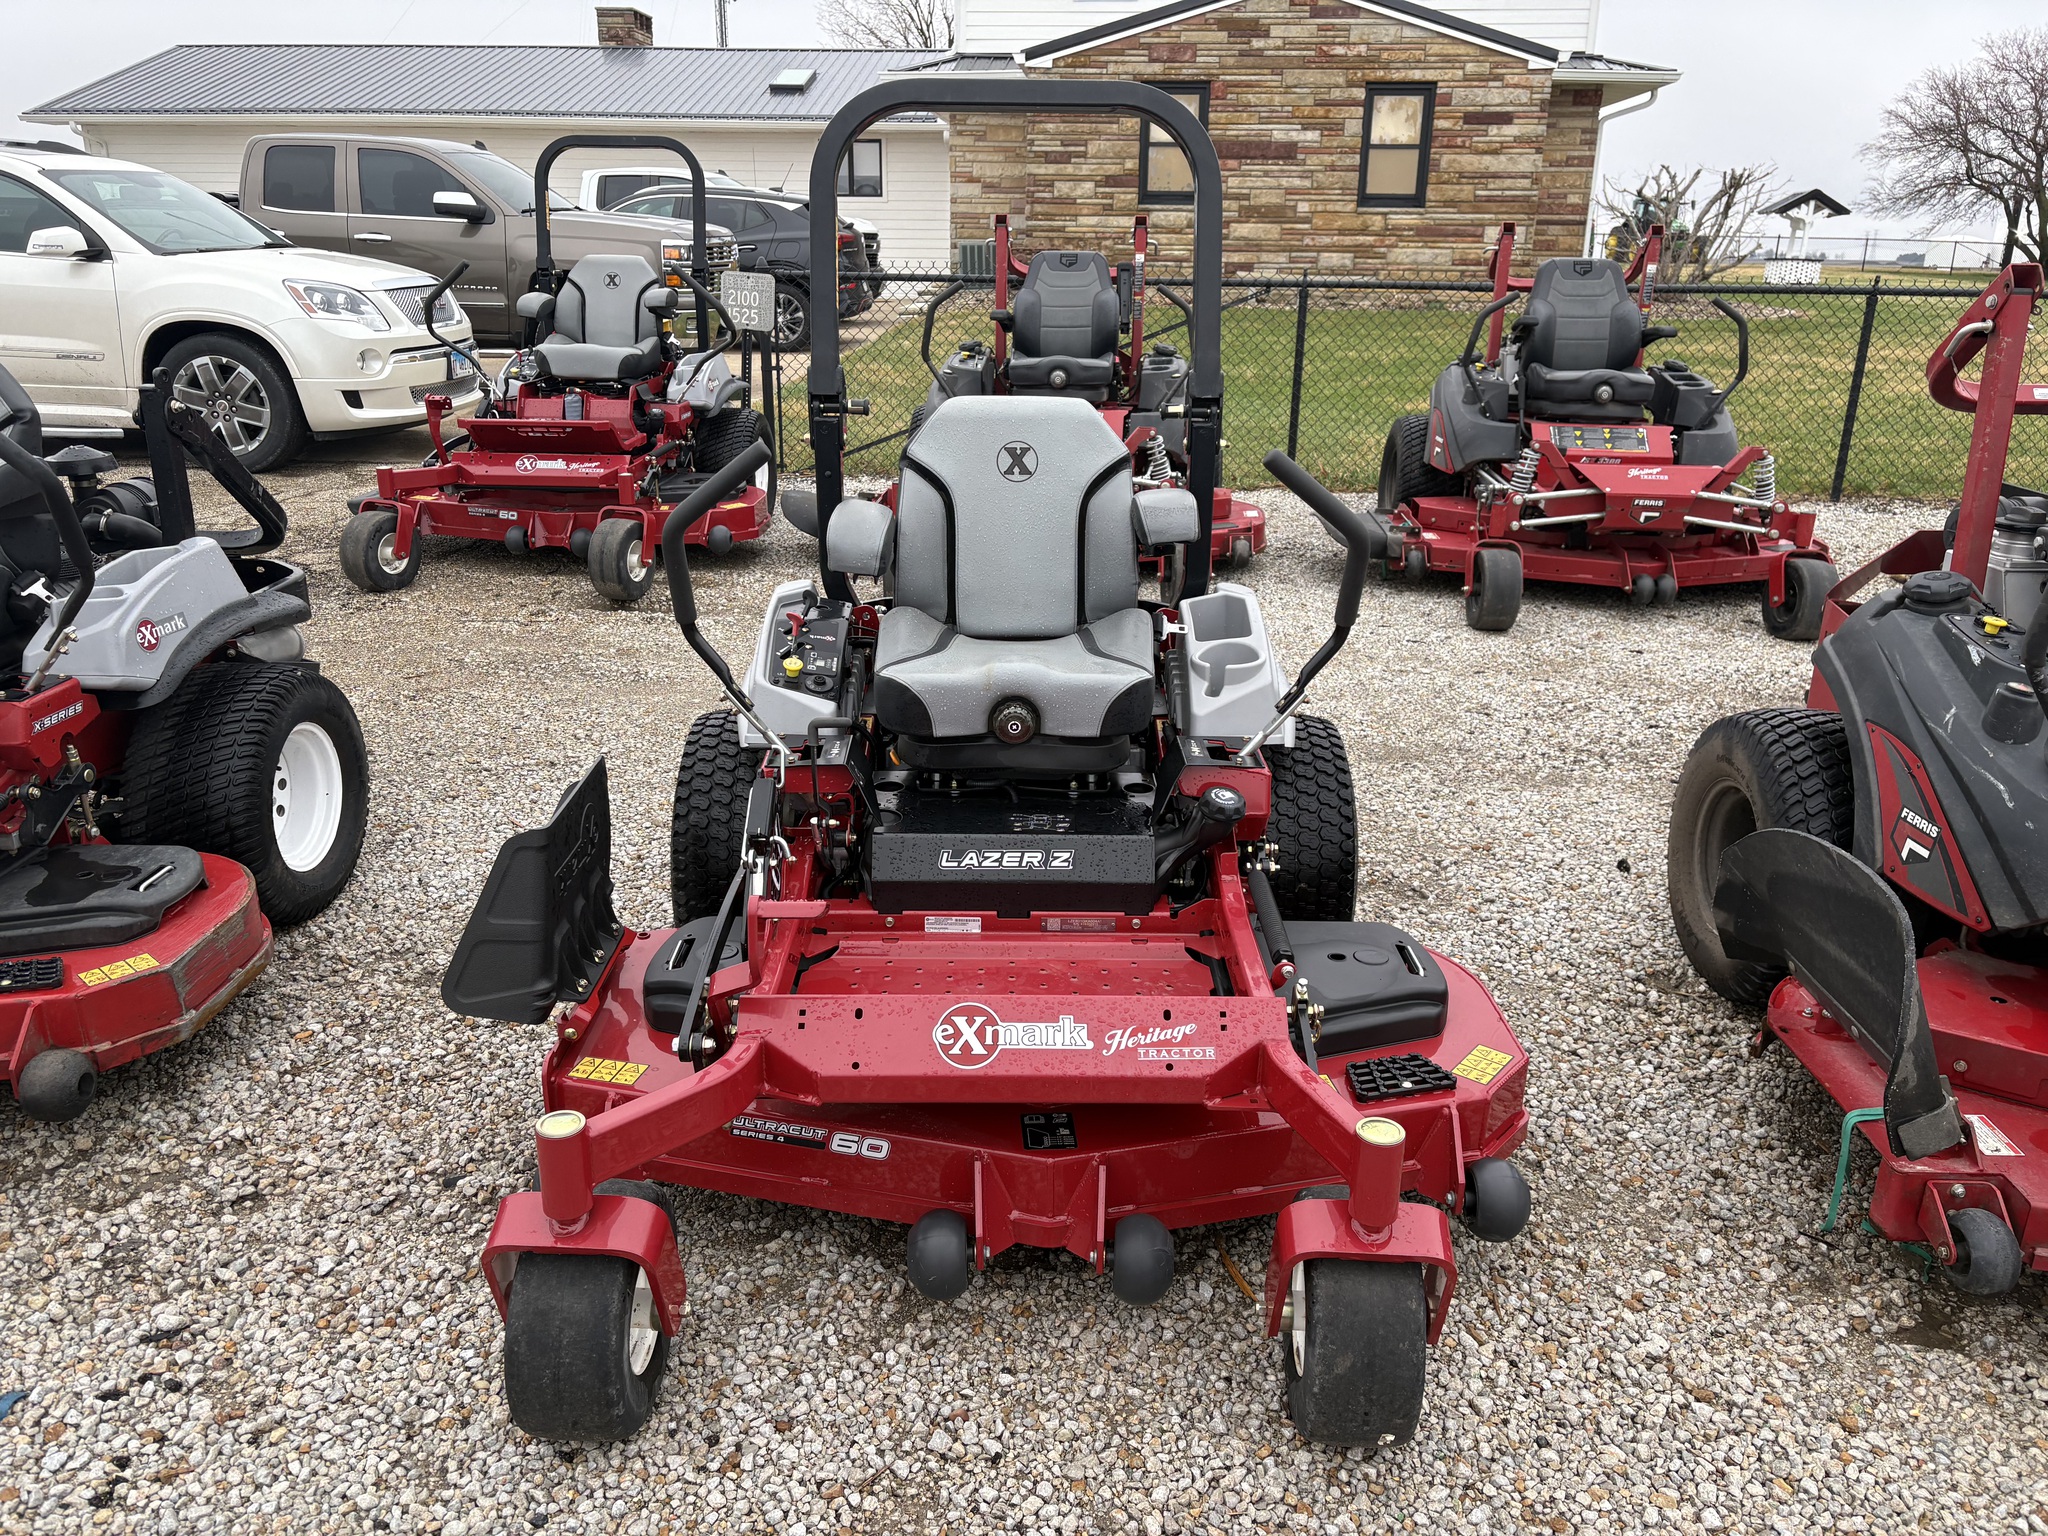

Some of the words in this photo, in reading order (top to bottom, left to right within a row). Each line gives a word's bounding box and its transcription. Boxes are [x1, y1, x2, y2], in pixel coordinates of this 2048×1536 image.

[728, 289, 759, 306] 2100
[728, 307, 759, 325] 1525
[1004, 447, 1032, 475] X
[1627, 467, 1662, 478] Heritage
[499, 511, 518, 520] 60
[1900, 807, 1938, 838] FERRIS
[939, 850, 1046, 870] LAZER
[1047, 850, 1075, 870] Z
[1102, 1023, 1197, 1057] Heritage
[1137, 1048, 1216, 1060] TRACTOR
[732, 1129, 774, 1141] SERIES
[777, 1135, 785, 1143] 4
[732, 1116, 828, 1141] ULTRACUT
[829, 1132, 891, 1160] 60
